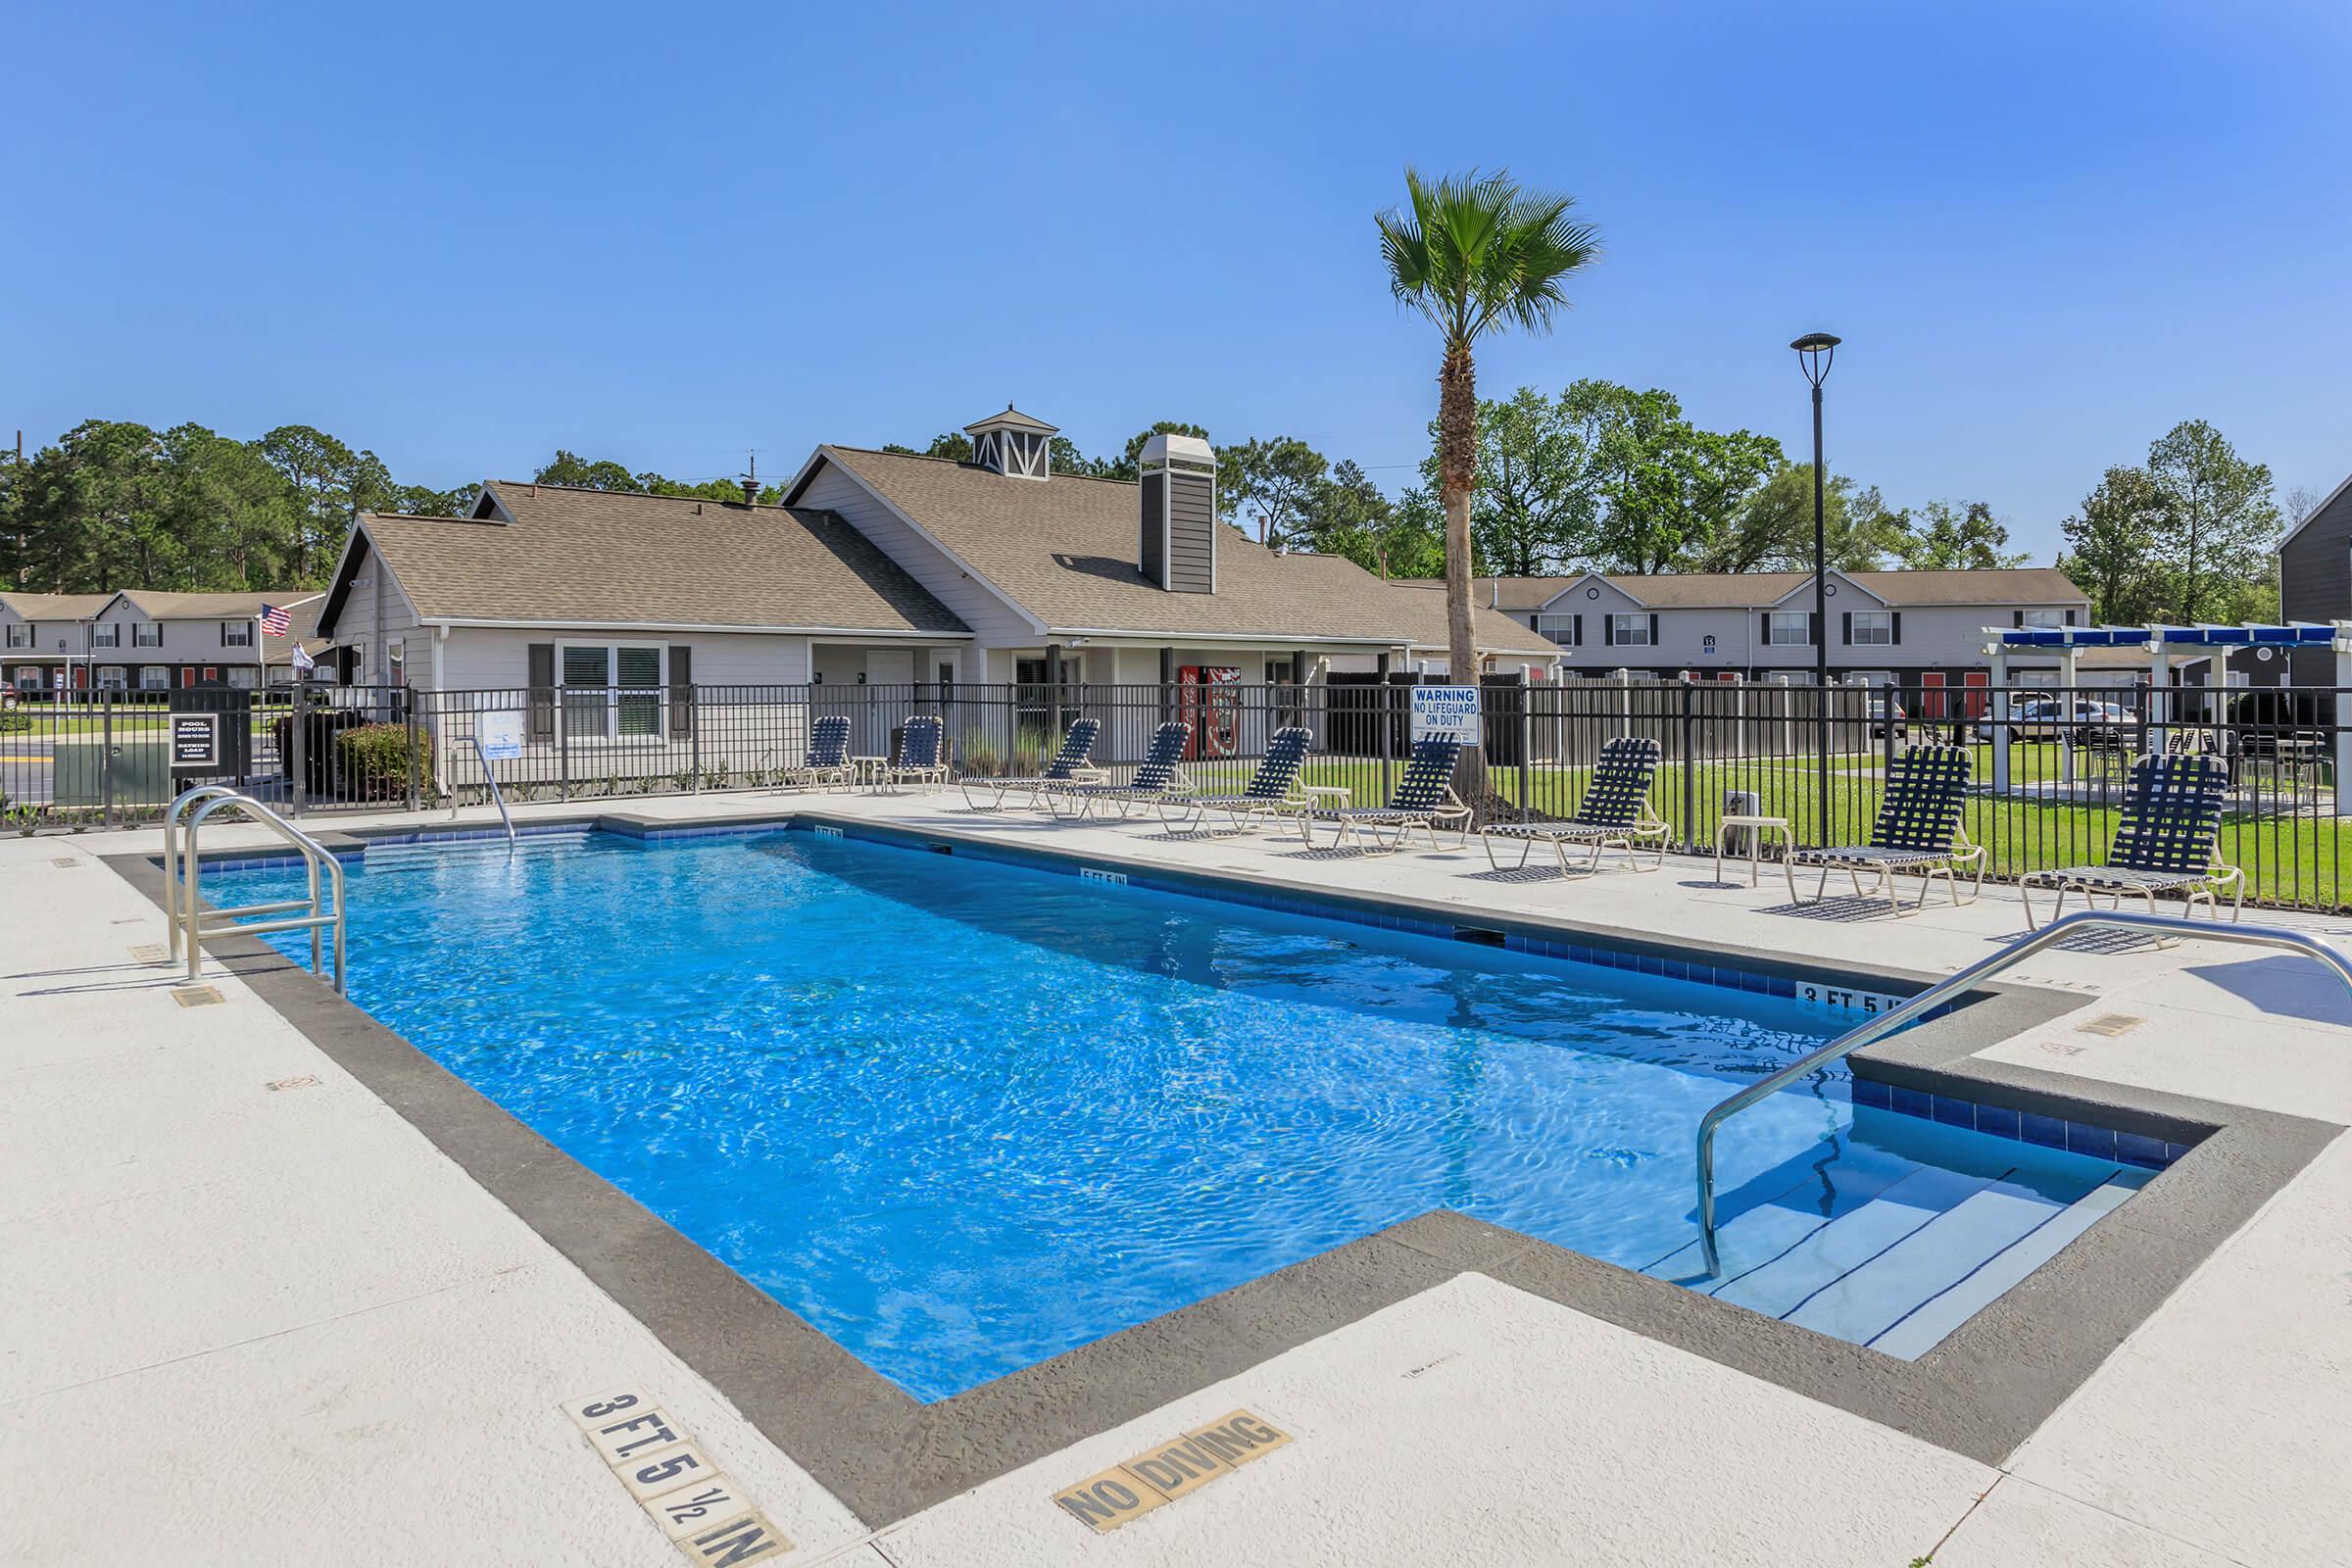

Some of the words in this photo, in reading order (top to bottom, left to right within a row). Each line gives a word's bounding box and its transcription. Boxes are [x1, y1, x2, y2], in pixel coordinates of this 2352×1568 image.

[1414, 703, 1426, 713] NO
[1428, 703, 1477, 714] LIFEGUARD
[1416, 690, 1475, 702] WARNING
[1426, 714, 1438, 725] ON
[1441, 714, 1464, 726] DUTY
[1804, 987, 1817, 1003] 3
[1827, 990, 1852, 1008] FT
[1864, 996, 1877, 1012] 5
[581, 1394, 638, 1418] 3
[600, 1412, 678, 1458] FT.
[636, 1453, 700, 1484] 5
[1058, 1480, 1140, 1526] NO
[1131, 1416, 1281, 1492] DIVING
[693, 1517, 777, 1568] IN
